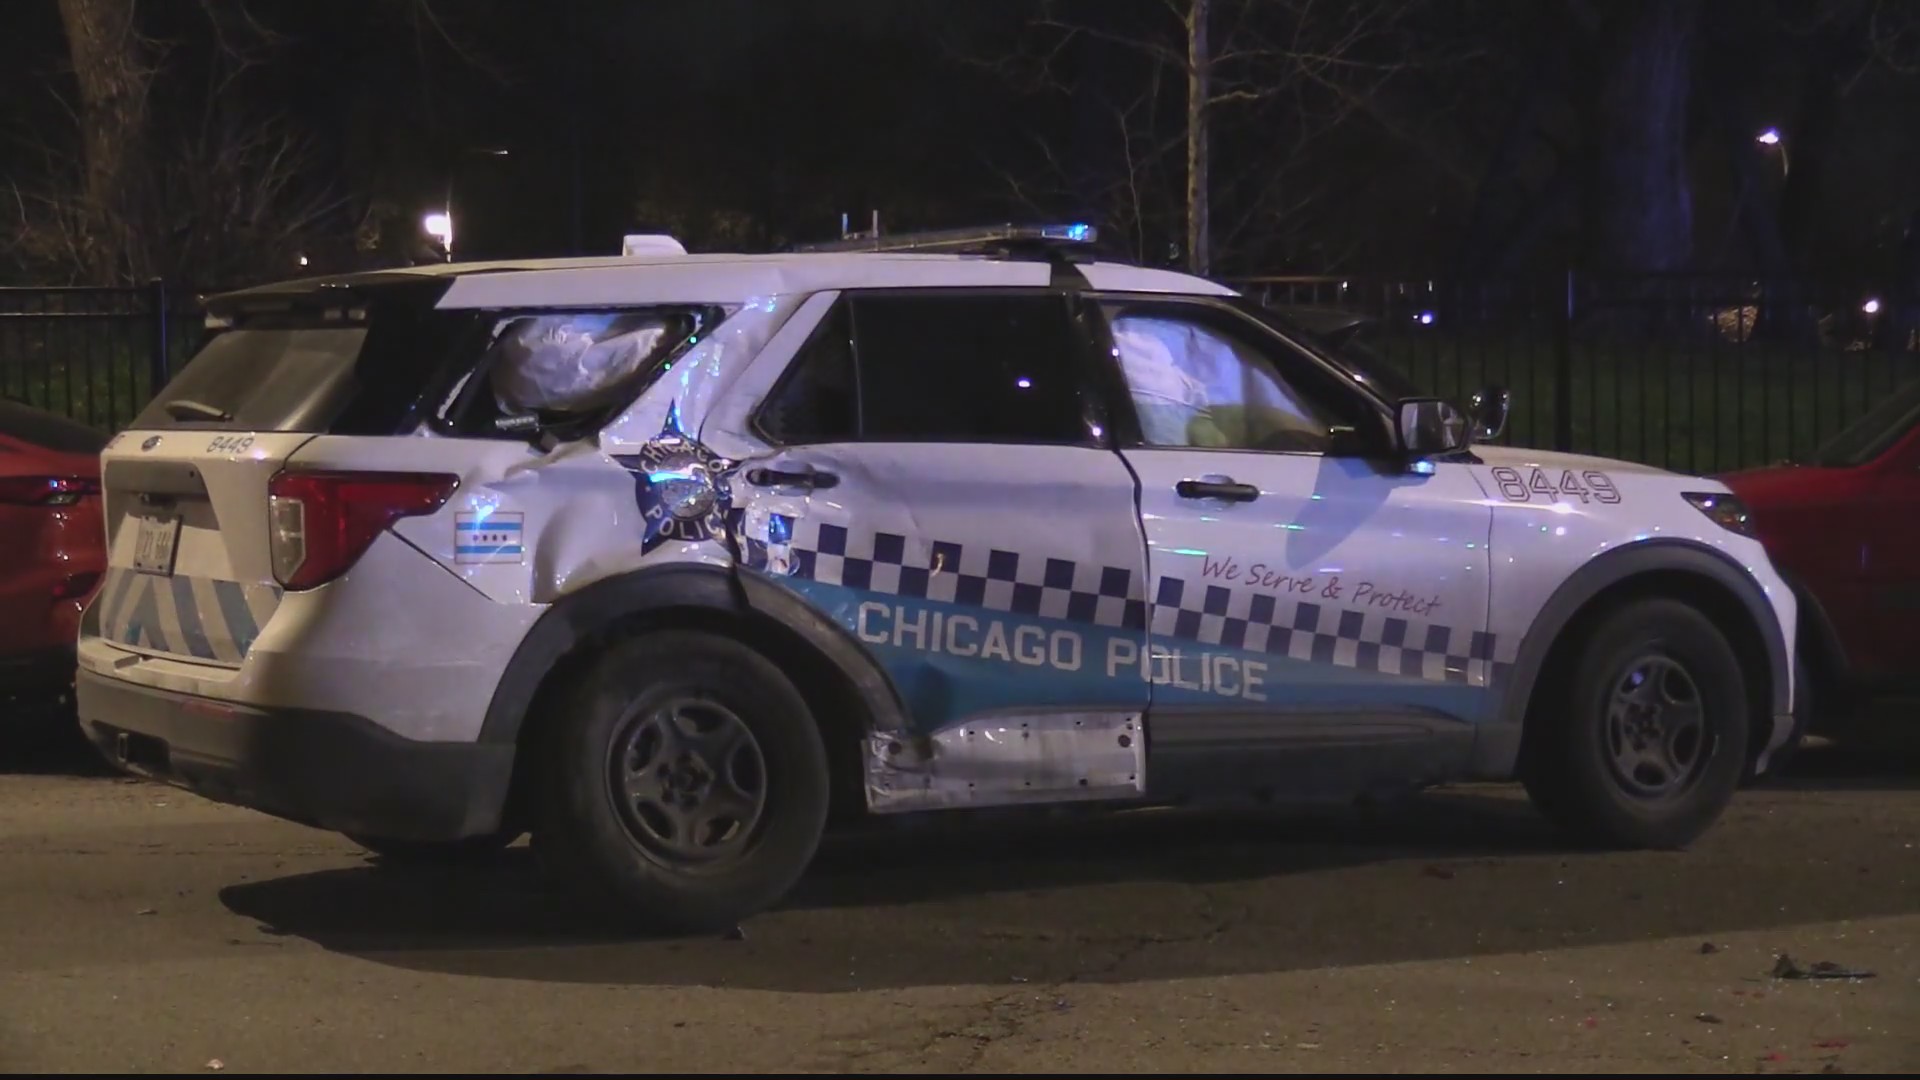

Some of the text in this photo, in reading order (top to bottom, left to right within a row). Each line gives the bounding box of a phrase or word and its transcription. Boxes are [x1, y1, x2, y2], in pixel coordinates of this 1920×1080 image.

[206, 435, 254, 454] 8449
[641, 440, 723, 475] CHICAGO
[1490, 466, 1621, 504] 8449
[1201, 554, 1441, 617] We Serve & Protect
[857, 600, 1269, 702] CHICAGO POLICE
